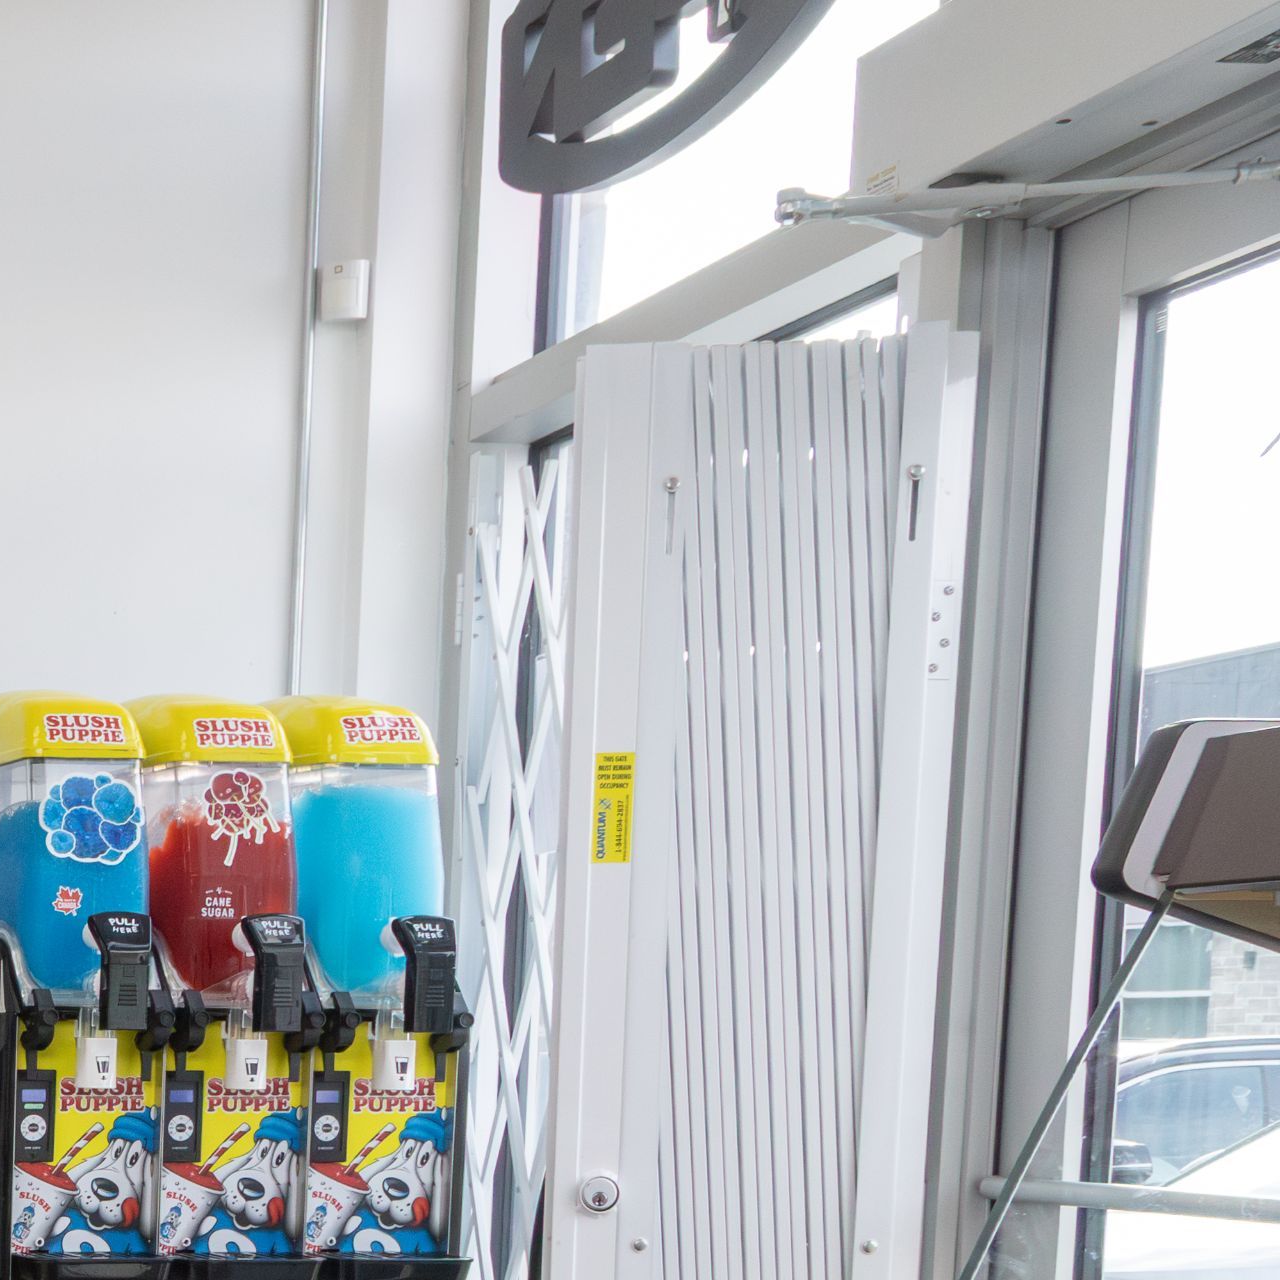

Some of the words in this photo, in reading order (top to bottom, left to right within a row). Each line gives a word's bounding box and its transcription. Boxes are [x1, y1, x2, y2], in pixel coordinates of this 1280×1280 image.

[45, 714, 123, 732] SLUSH
[193, 718, 272, 735] SLUSH
[340, 715, 417, 732] SLUSH
[596, 811, 607, 859] QUANTUM
[204, 896, 232, 908] CANE
[200, 906, 235, 919] SUGAR
[108, 917, 139, 929] PULL
[260, 920, 291, 931] PULL
[412, 922, 444, 933] PULL
[112, 925, 139, 935] HERE
[264, 929, 291, 938] HERE
[417, 930, 444, 940] HERE
[18, 1190, 52, 1214] SLUSH
[165, 1190, 198, 1214] SLUSH
[311, 1189, 344, 1214] SLUSH
